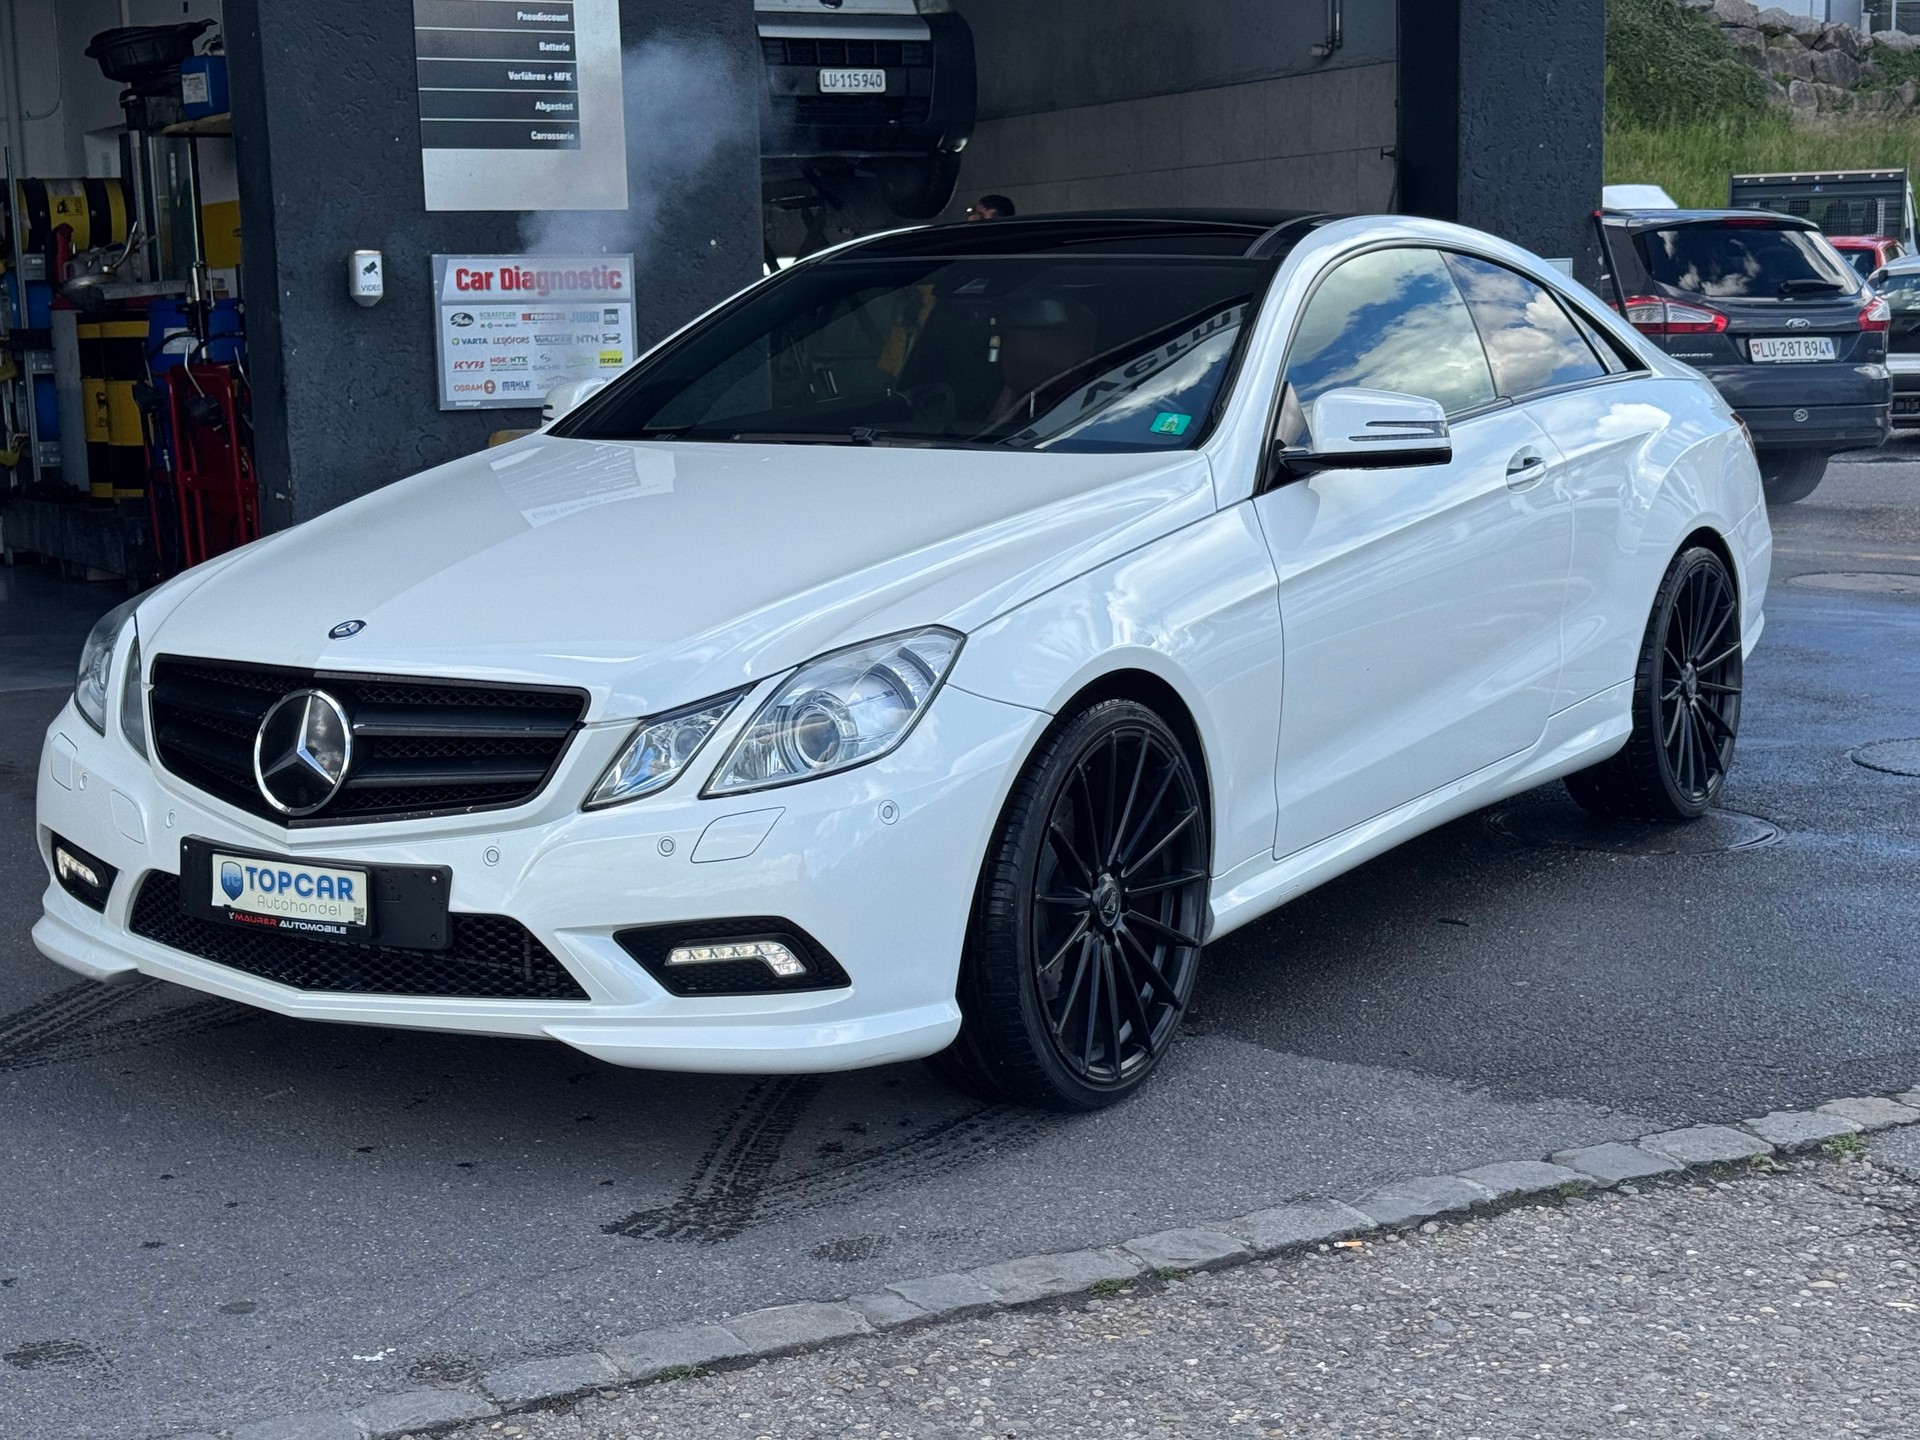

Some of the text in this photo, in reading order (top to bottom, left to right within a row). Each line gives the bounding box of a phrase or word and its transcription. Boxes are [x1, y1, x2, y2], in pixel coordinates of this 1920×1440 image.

[517, 11, 569, 22] Pneudiscount
[539, 42, 570, 52] Batterie
[507, 70, 546, 81] Vorführen
[553, 71, 573, 81] MFK
[534, 101, 574, 112] Abgastest
[530, 130, 575, 141] Carrosserie
[455, 265, 622, 297] Car Diagnostic
[361, 284, 381, 292] VIDEO
[569, 311, 600, 323] JURID
[534, 335, 572, 344] WALKER
[576, 335, 599, 343] NTN
[454, 360, 486, 369] KYB
[510, 356, 528, 364] NTK
[453, 384, 483, 392] OSRAM
[502, 381, 530, 391] MAHLE
[245, 866, 354, 901] TOPCAR
[257, 895, 342, 916] Autohandel
[234, 913, 348, 934] MAURER AUTOMOBILE
